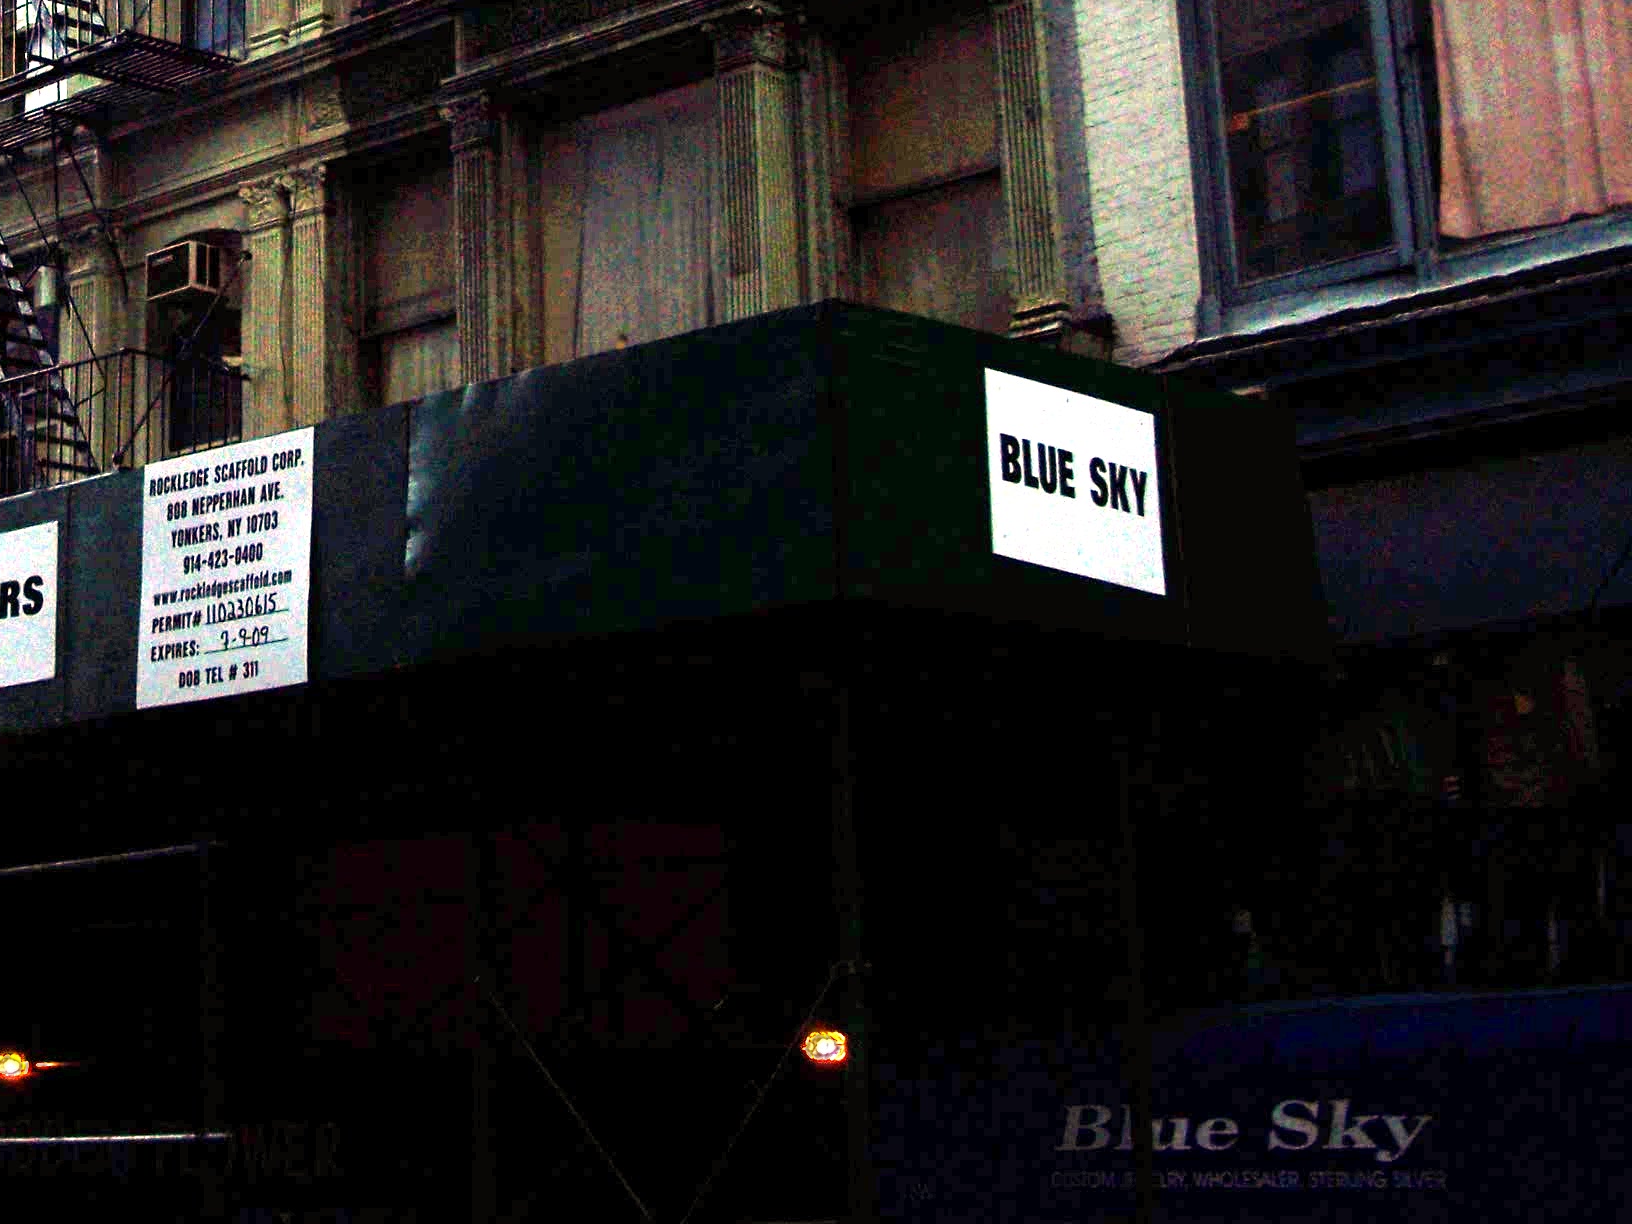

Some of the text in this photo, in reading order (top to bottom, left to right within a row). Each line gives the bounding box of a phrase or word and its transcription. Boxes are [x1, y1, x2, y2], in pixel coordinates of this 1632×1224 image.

[149, 448, 304, 496] ROCKLEDGE SCAFFOLD CORP.
[999, 432, 1147, 517] BLUE SKY
[191, 486, 255, 516] NEPPERHAN
[260, 481, 285, 501] AVE.
[171, 510, 279, 549] YONKERS, NY 10703
[183, 542, 263, 575] 914-423-0400
[153, 568, 292, 606] www.rockledgescaffold.com
[151, 639, 200, 663] EXPIRES:
[205, 666, 224, 685] TEL
[228, 663, 238, 681] #
[243, 660, 259, 679] 311
[1053, 1098, 1432, 1163] Blue Sky
